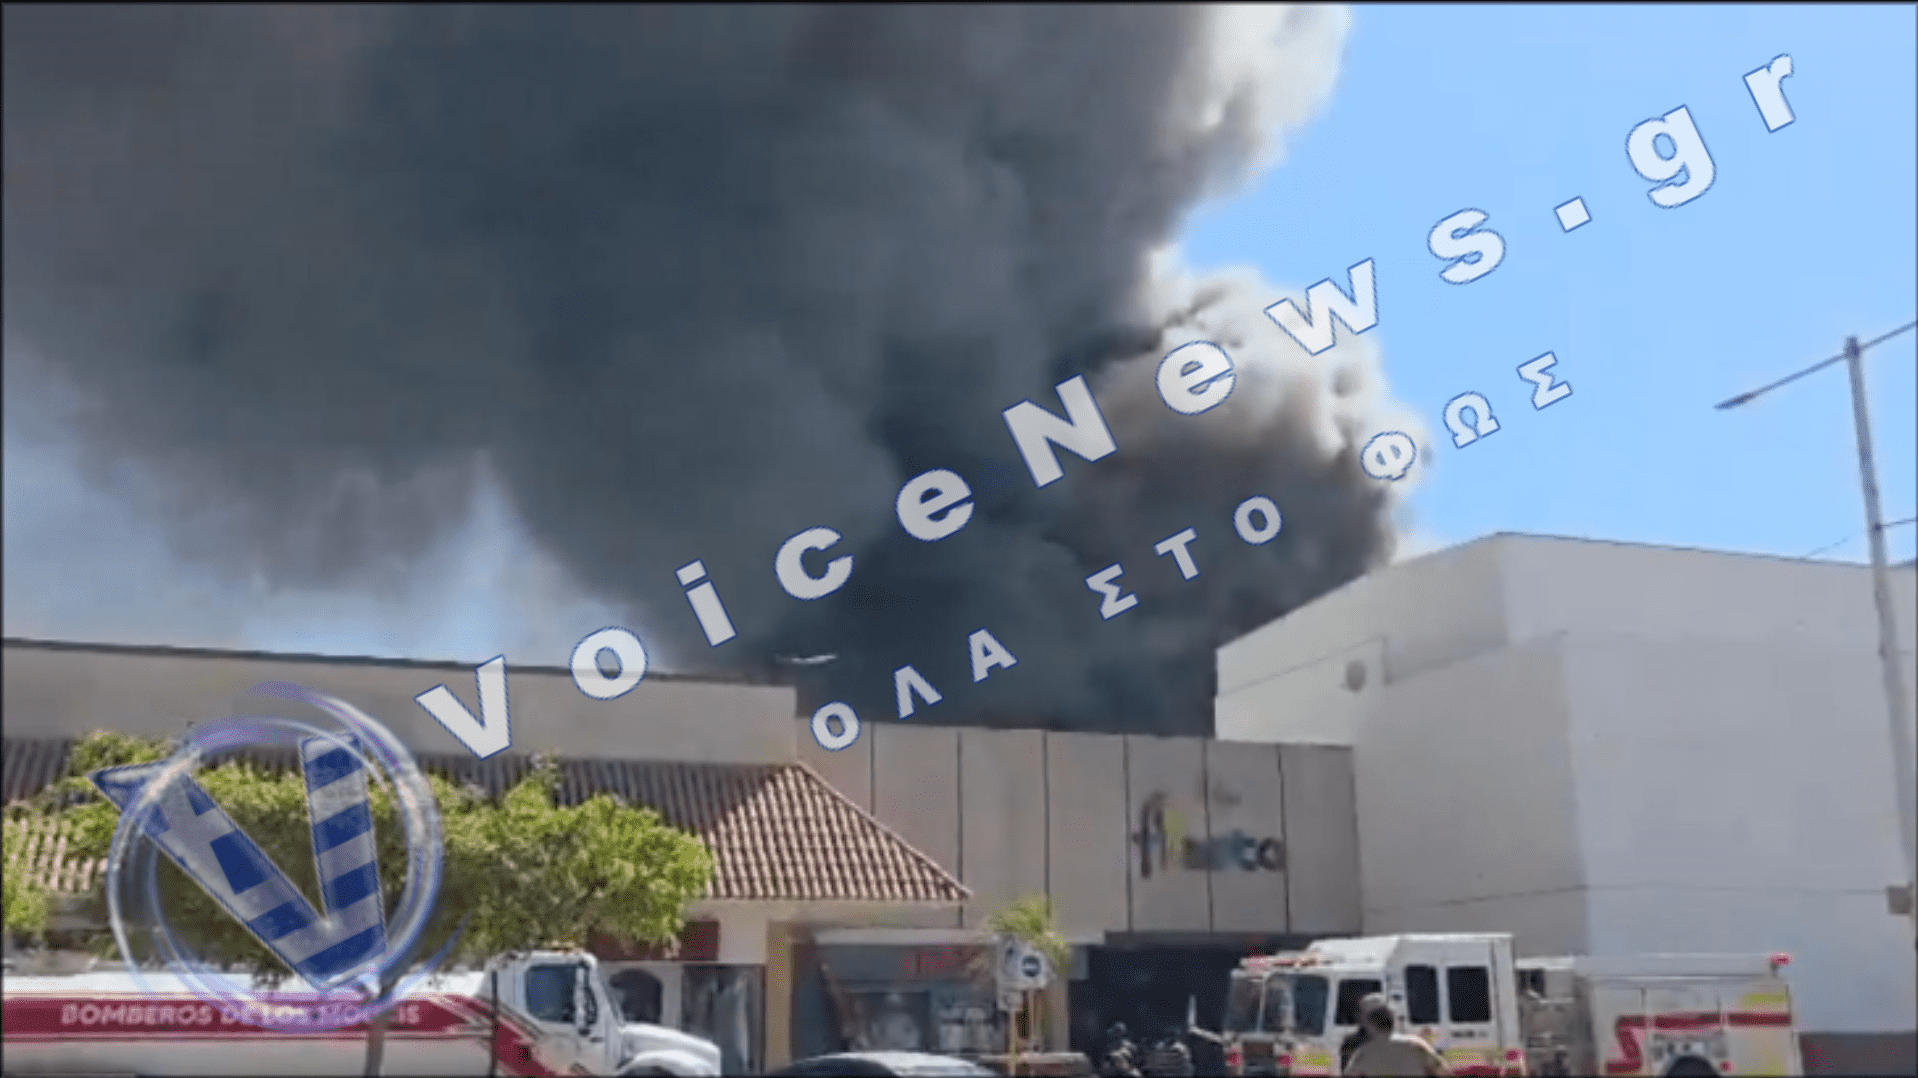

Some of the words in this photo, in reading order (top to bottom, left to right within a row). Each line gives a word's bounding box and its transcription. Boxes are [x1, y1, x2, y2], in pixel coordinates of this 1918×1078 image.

[59, 1003, 214, 1026] BOMBEROS
[221, 1003, 256, 1026] DE
[316, 1003, 421, 1026] MOIS
